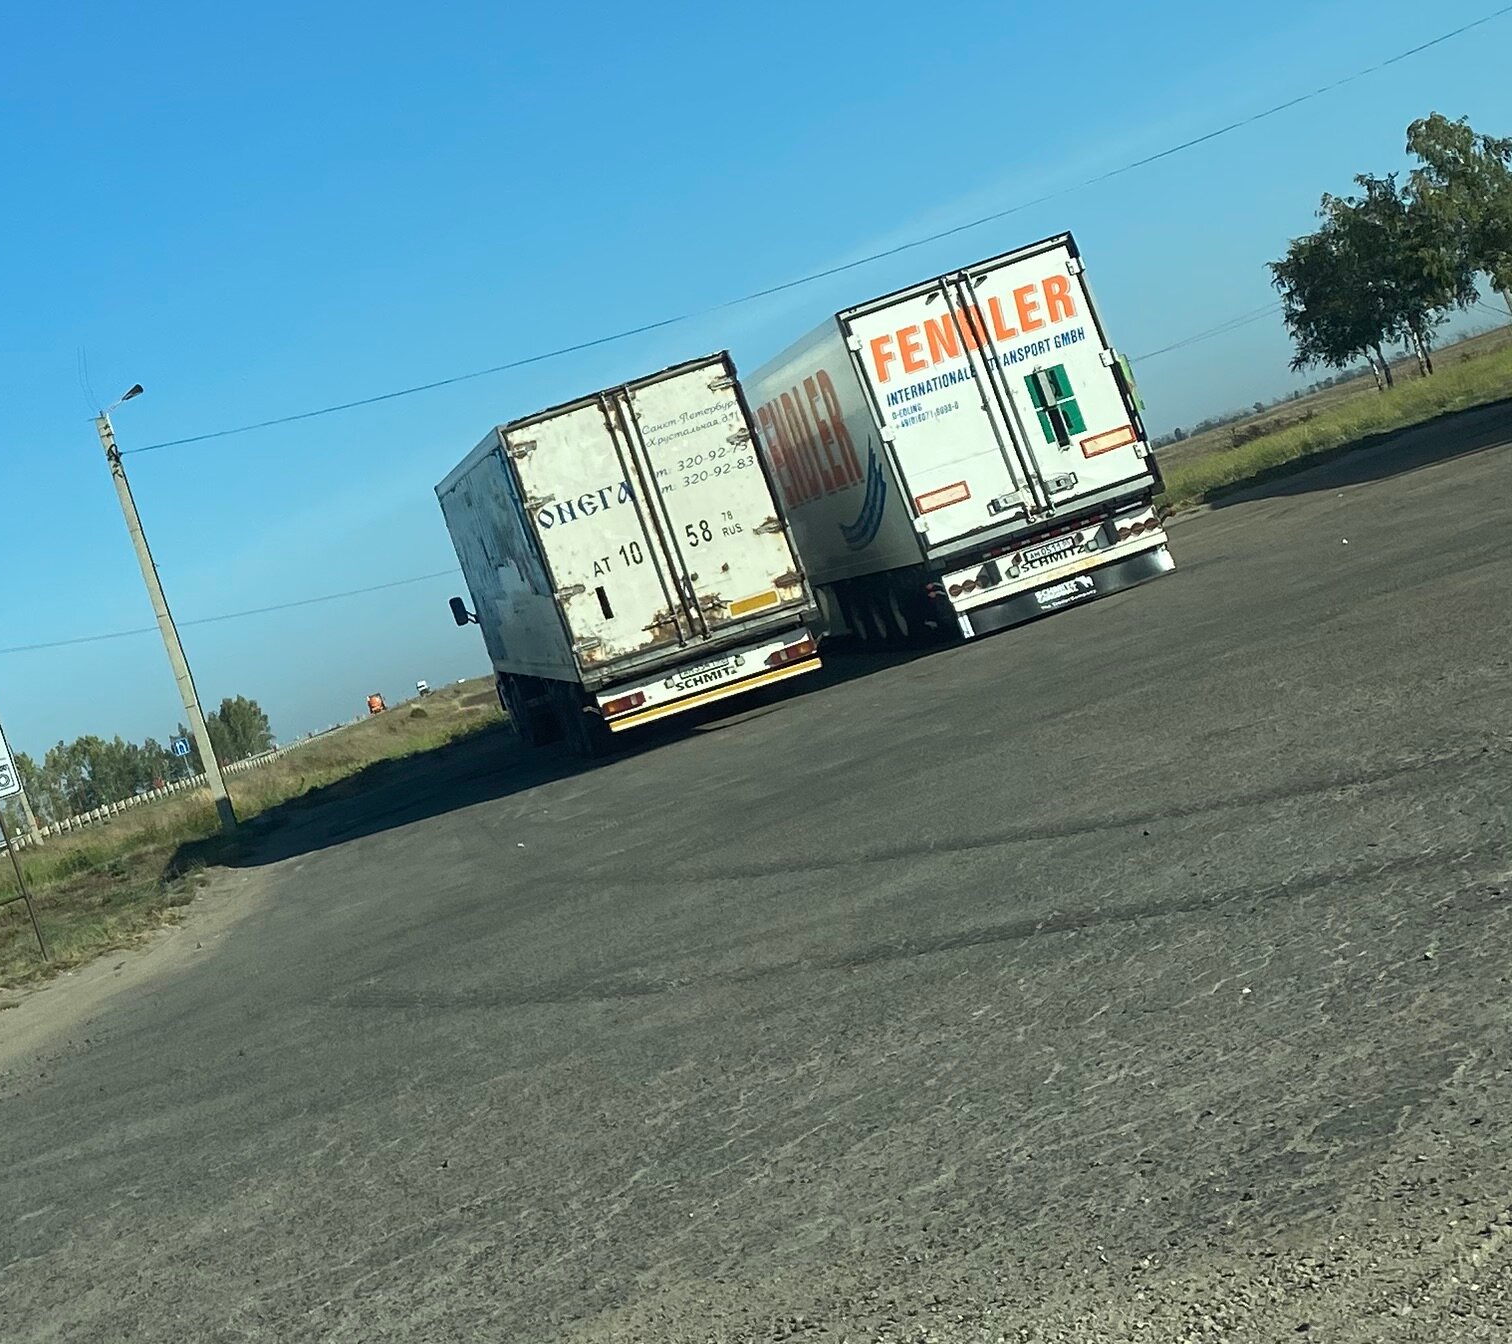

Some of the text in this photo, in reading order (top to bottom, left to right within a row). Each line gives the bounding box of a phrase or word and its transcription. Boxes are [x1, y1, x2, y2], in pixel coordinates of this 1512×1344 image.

[886, 327, 1086, 407] INTERNATIONALE TANSPORT GMBH
[683, 456, 754, 488] 320-92-83
[619, 541, 643, 567] 10
[685, 519, 713, 547] 58
[721, 523, 743, 537] RUS
